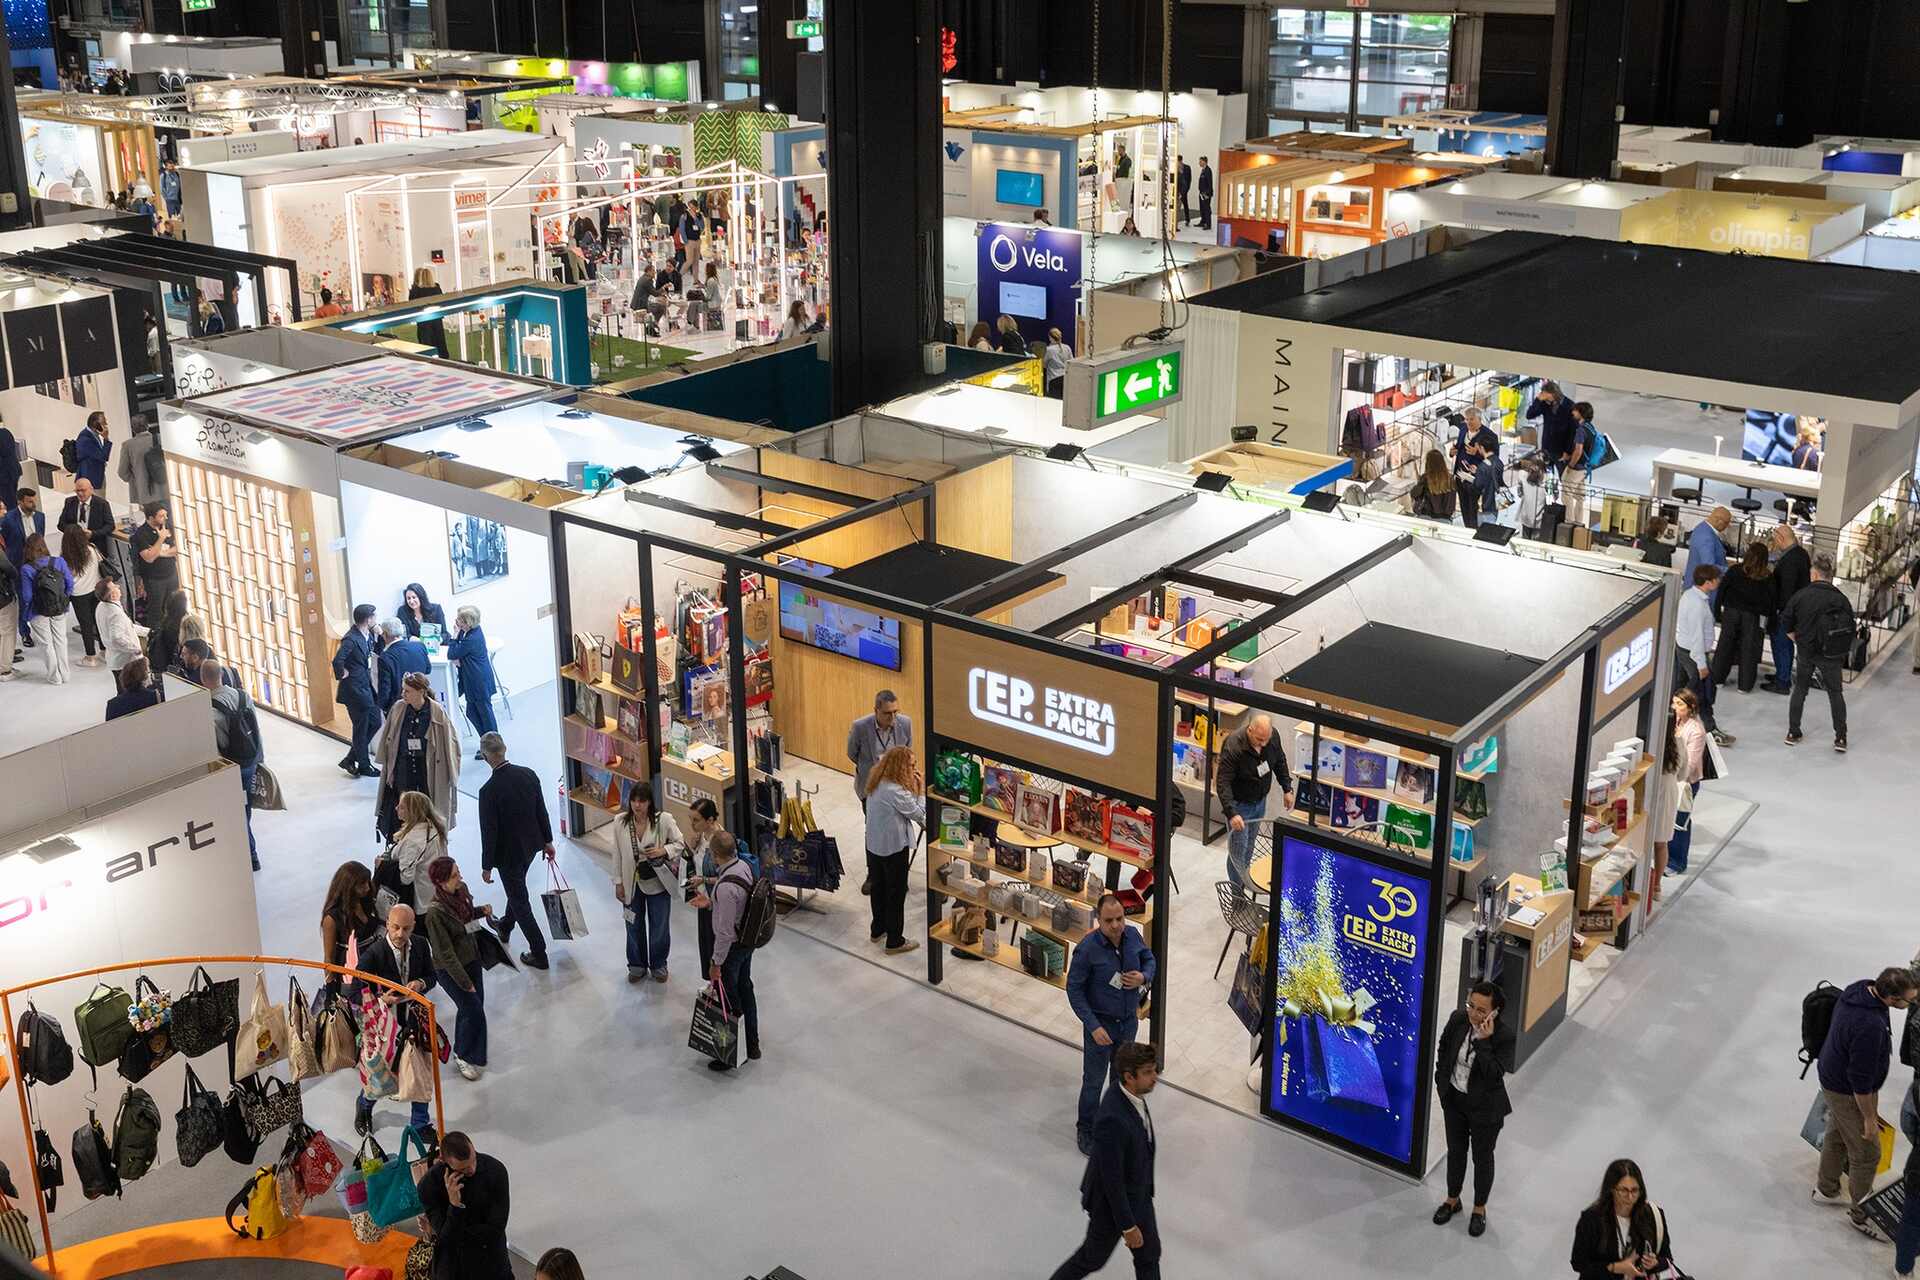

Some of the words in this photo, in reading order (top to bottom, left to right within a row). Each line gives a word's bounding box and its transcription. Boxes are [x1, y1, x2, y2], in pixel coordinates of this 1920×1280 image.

[1709, 222, 1807, 252] olimpia
[1022, 245, 1068, 272] Vela.
[1271, 338, 1292, 444] MAIN
[1045, 687, 1115, 725] EXTRA
[1045, 709, 1101, 743] PACK
[106, 820, 216, 883] art
[1367, 878, 1417, 922] 30
[1382, 925, 1416, 945] EXTRA
[1382, 934, 1408, 952] PACK
